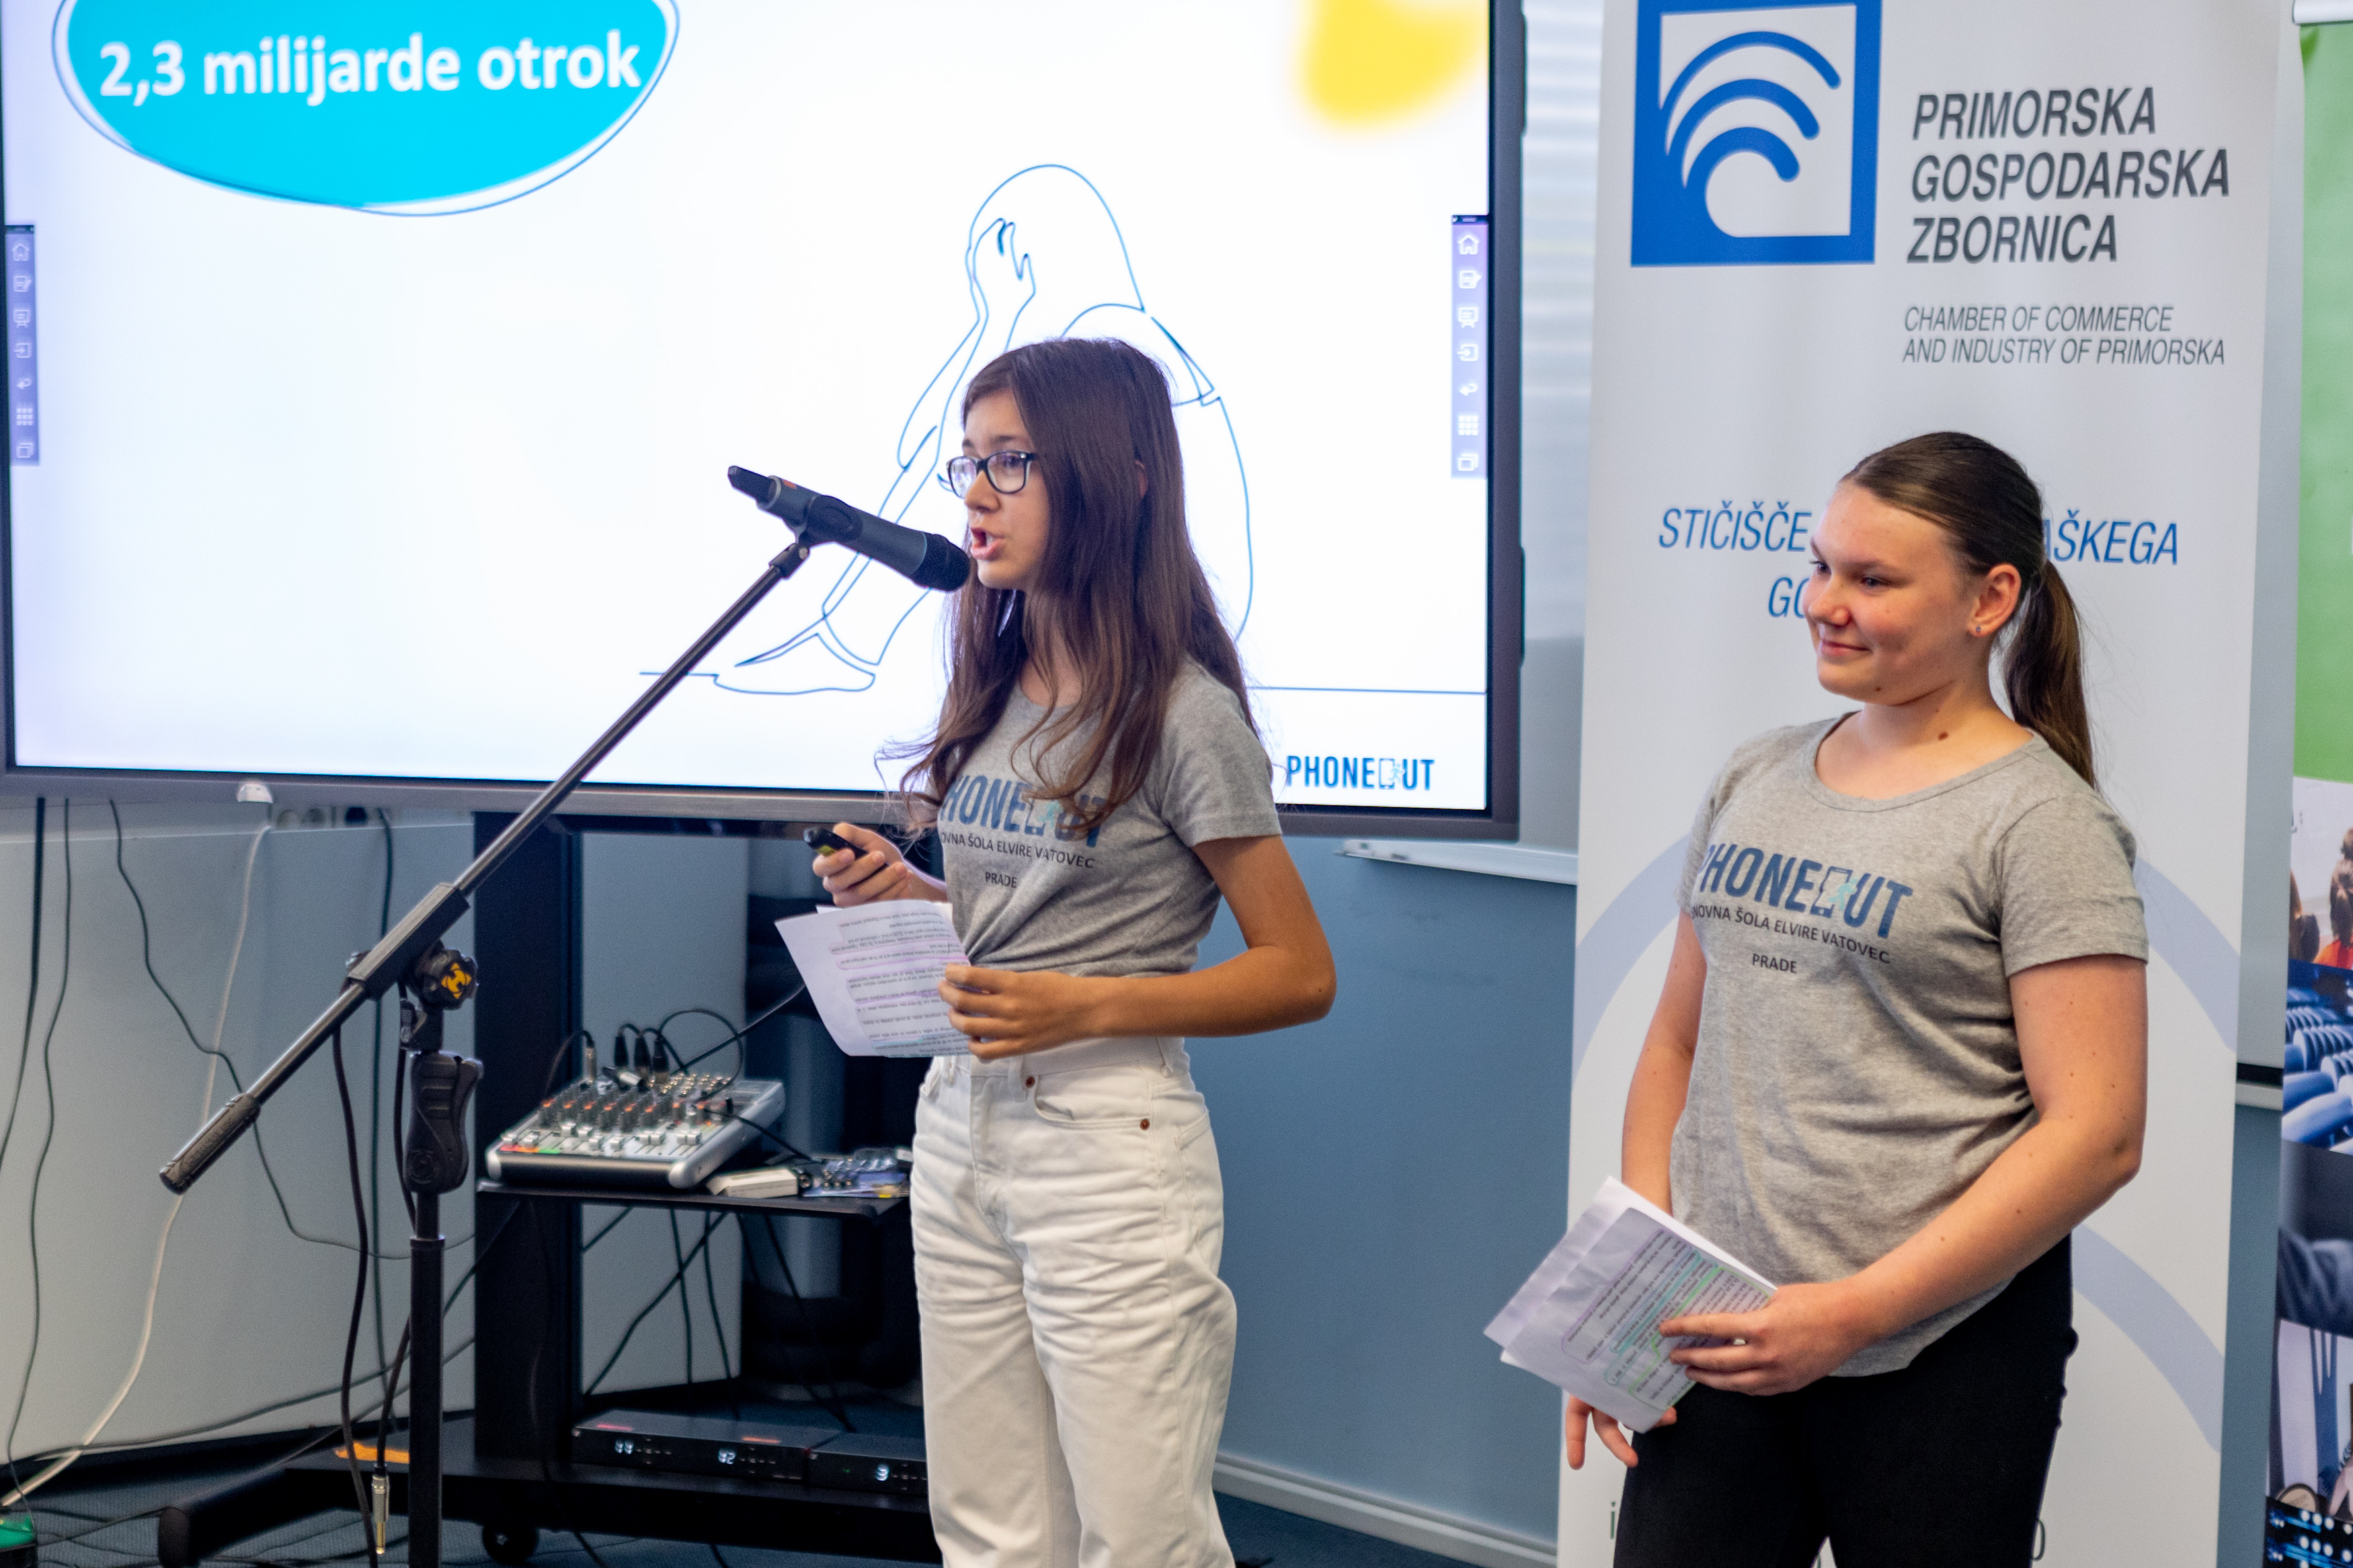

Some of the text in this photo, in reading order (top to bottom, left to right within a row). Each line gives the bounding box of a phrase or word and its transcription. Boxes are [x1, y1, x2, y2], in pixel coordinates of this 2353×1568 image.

[99, 29, 642, 108] 2,3 milijarde otrok
[1912, 87, 2156, 140] PRIMORSKA
[1911, 149, 2230, 203] GOSPODARSKA
[1907, 214, 2118, 264] ZBORNICA
[1904, 306, 2174, 332] CHAMBER OF COMMERCE
[1903, 338, 2225, 366] AND INDUSTRY OF PRIMORSKA
[1659, 500, 1812, 552] STIČIŠČE
[941, 831, 1096, 869] OVNA ŠOLA ELVIRE VATOVEC
[985, 871, 1018, 889] PRADE
[1734, 906, 1770, 931] ŠOLA
[1773, 919, 1819, 941] ELVIRE
[1821, 931, 1891, 964] VATOVEC
[1751, 952, 1798, 975] PRADE
